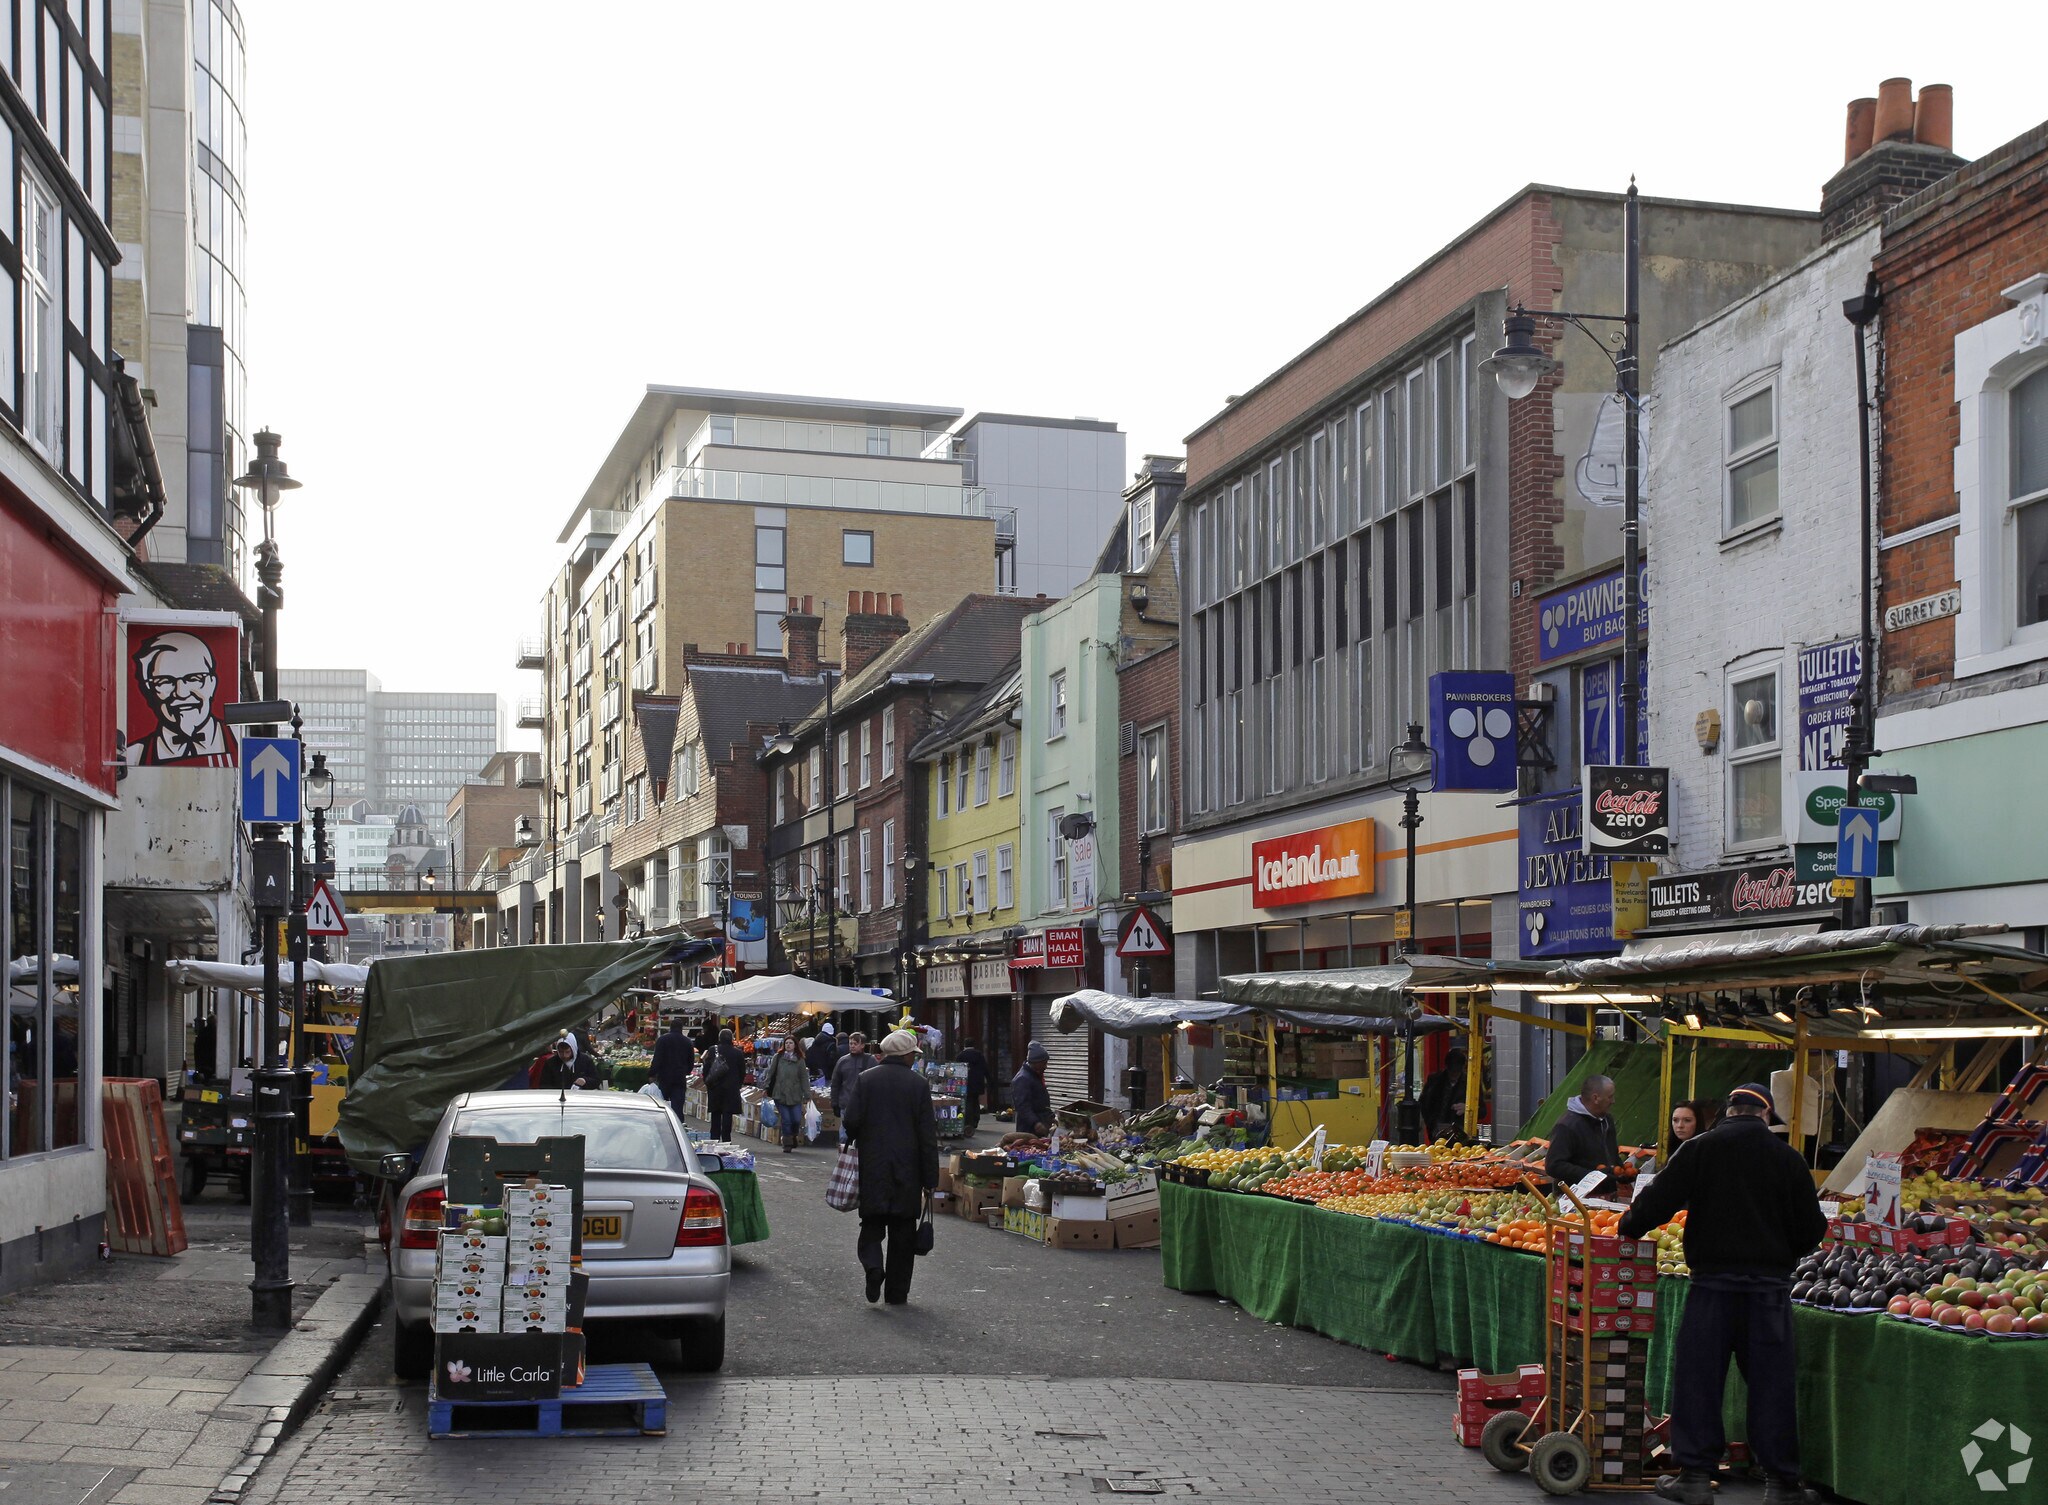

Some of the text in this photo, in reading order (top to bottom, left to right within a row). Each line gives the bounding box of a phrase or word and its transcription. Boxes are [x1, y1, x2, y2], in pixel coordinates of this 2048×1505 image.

[1567, 566, 1648, 629] PAWNBO
[1890, 600, 1936, 628] SURREY
[1583, 623, 1602, 642] BUY
[1605, 615, 1624, 635] BAC
[1585, 671, 1609, 698] OPEN
[1800, 682, 1827, 695] NEWSAGENT
[1446, 692, 1512, 702] PAWNBROKERS
[1814, 689, 1849, 704] CONFECTIONER
[1588, 696, 1607, 750] 7
[1807, 710, 1832, 726] ORDER
[1595, 789, 1662, 815] Coca-Cola
[1815, 795, 1885, 810] Specvers
[1606, 813, 1646, 828] zero
[1075, 841, 1092, 862] sale
[1258, 844, 1360, 892] Iceland.co.uk
[1651, 882, 1700, 907] TULLETTS
[1733, 867, 1797, 912] Coca-Cola
[1520, 899, 1551, 909] PAWNBROKERS
[1570, 904, 1597, 916] CHEQUES
[1651, 904, 1711, 918] NEWSAGENTS GREETING CARDS
[1050, 931, 1078, 941] EMAN
[1549, 928, 1589, 942] VALUATIONS
[1590, 927, 1604, 939] FOR
[1023, 938, 1039, 954] EMAN
[1048, 943, 1081, 952] HALAL
[1052, 955, 1079, 964] MEAT
[477, 1366, 550, 1382] Little Carla
